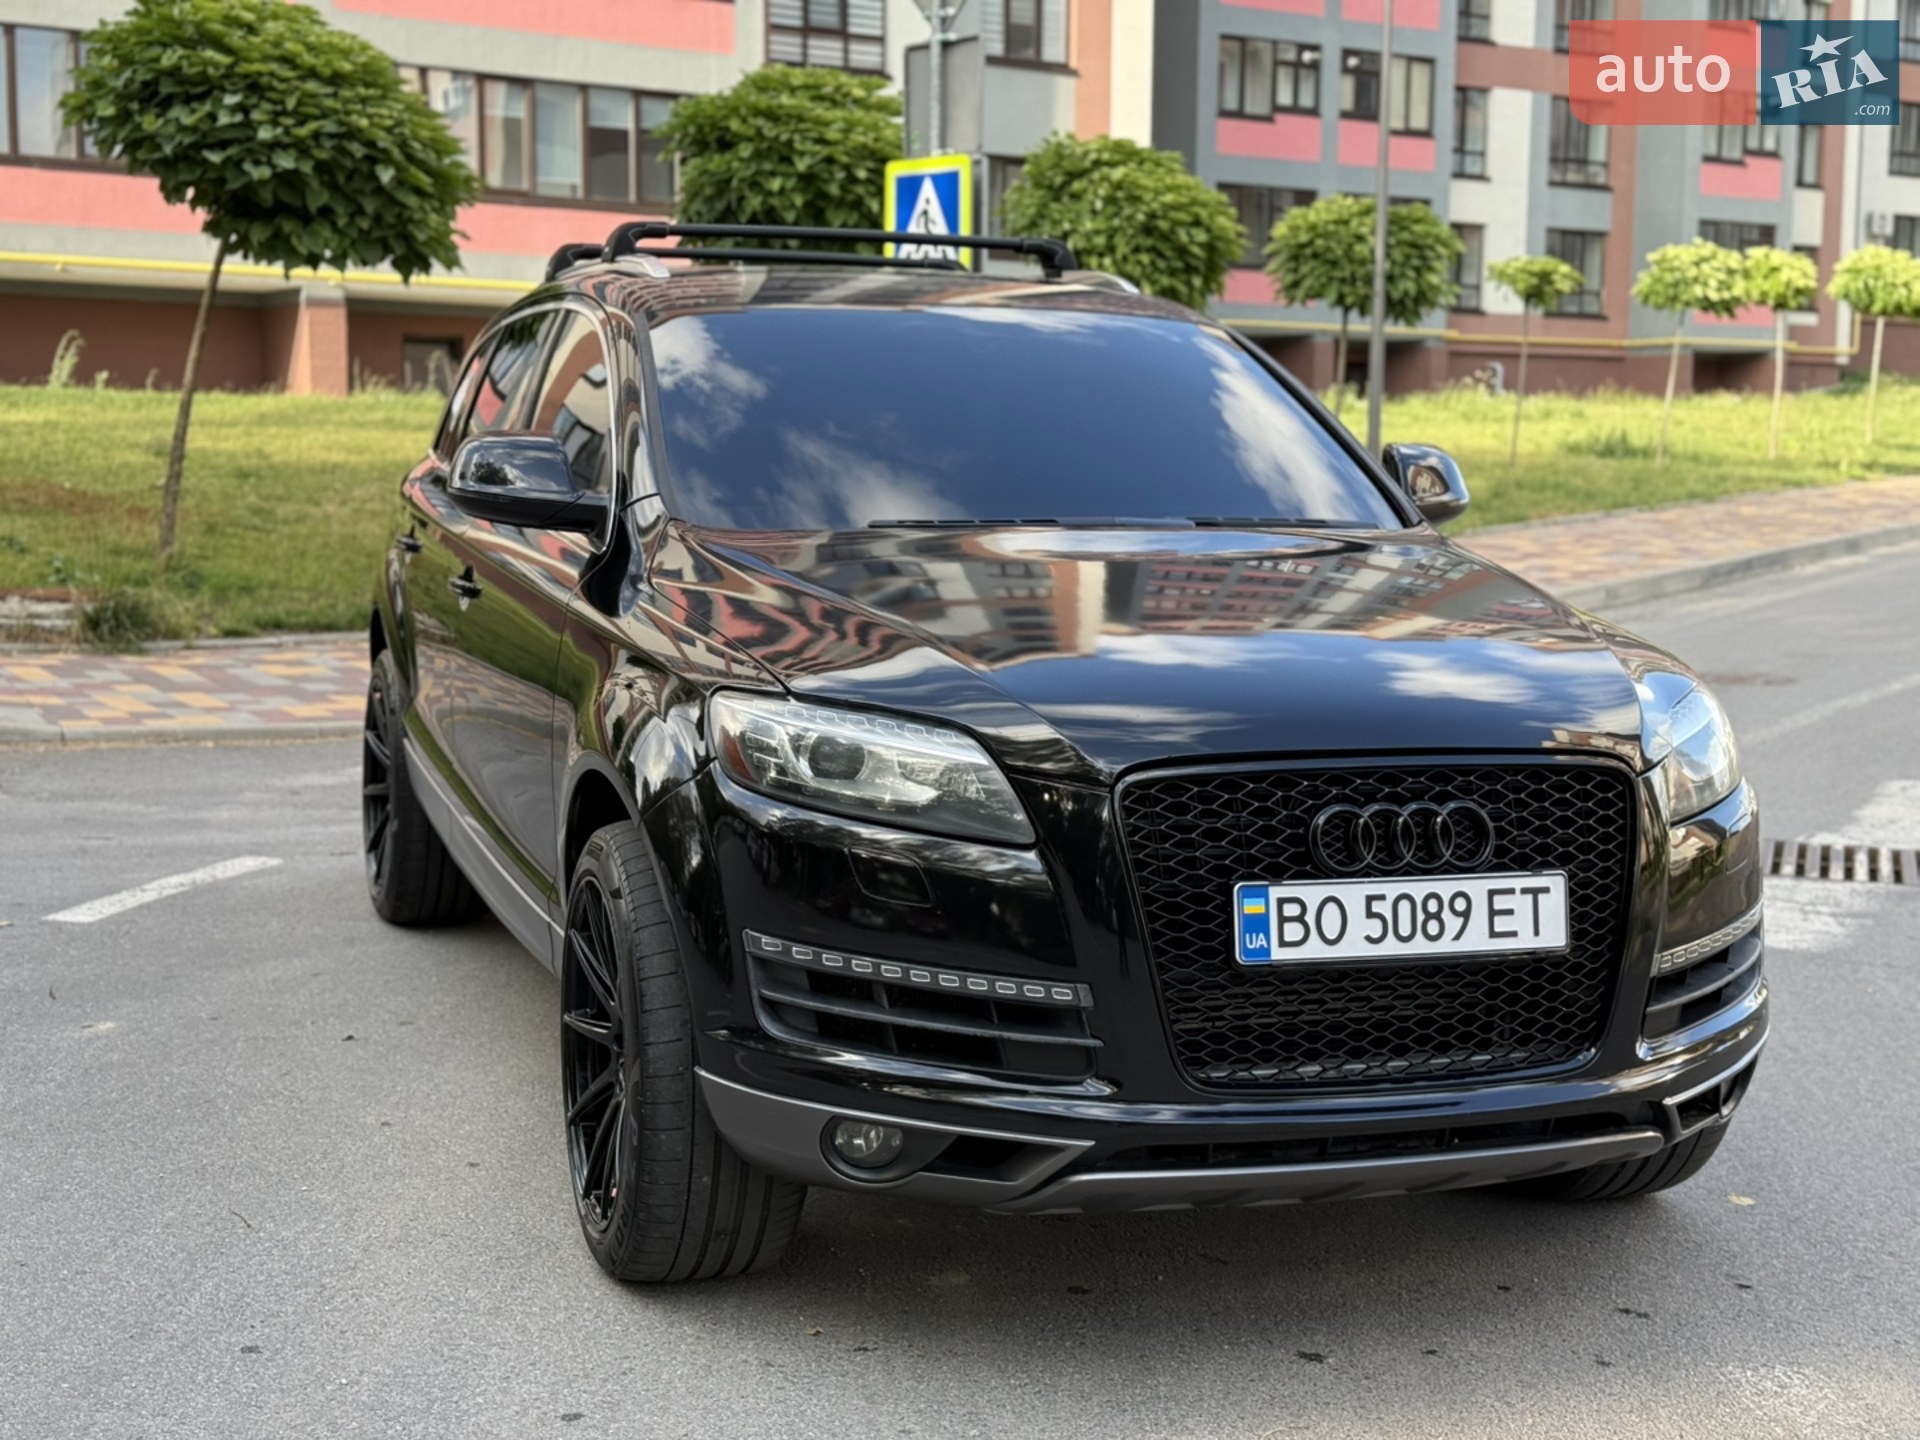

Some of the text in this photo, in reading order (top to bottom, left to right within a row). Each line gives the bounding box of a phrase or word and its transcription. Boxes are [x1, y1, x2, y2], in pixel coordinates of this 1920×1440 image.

[1275, 886, 1551, 948] BO 5089 ET
[1245, 933, 1268, 949] UA
